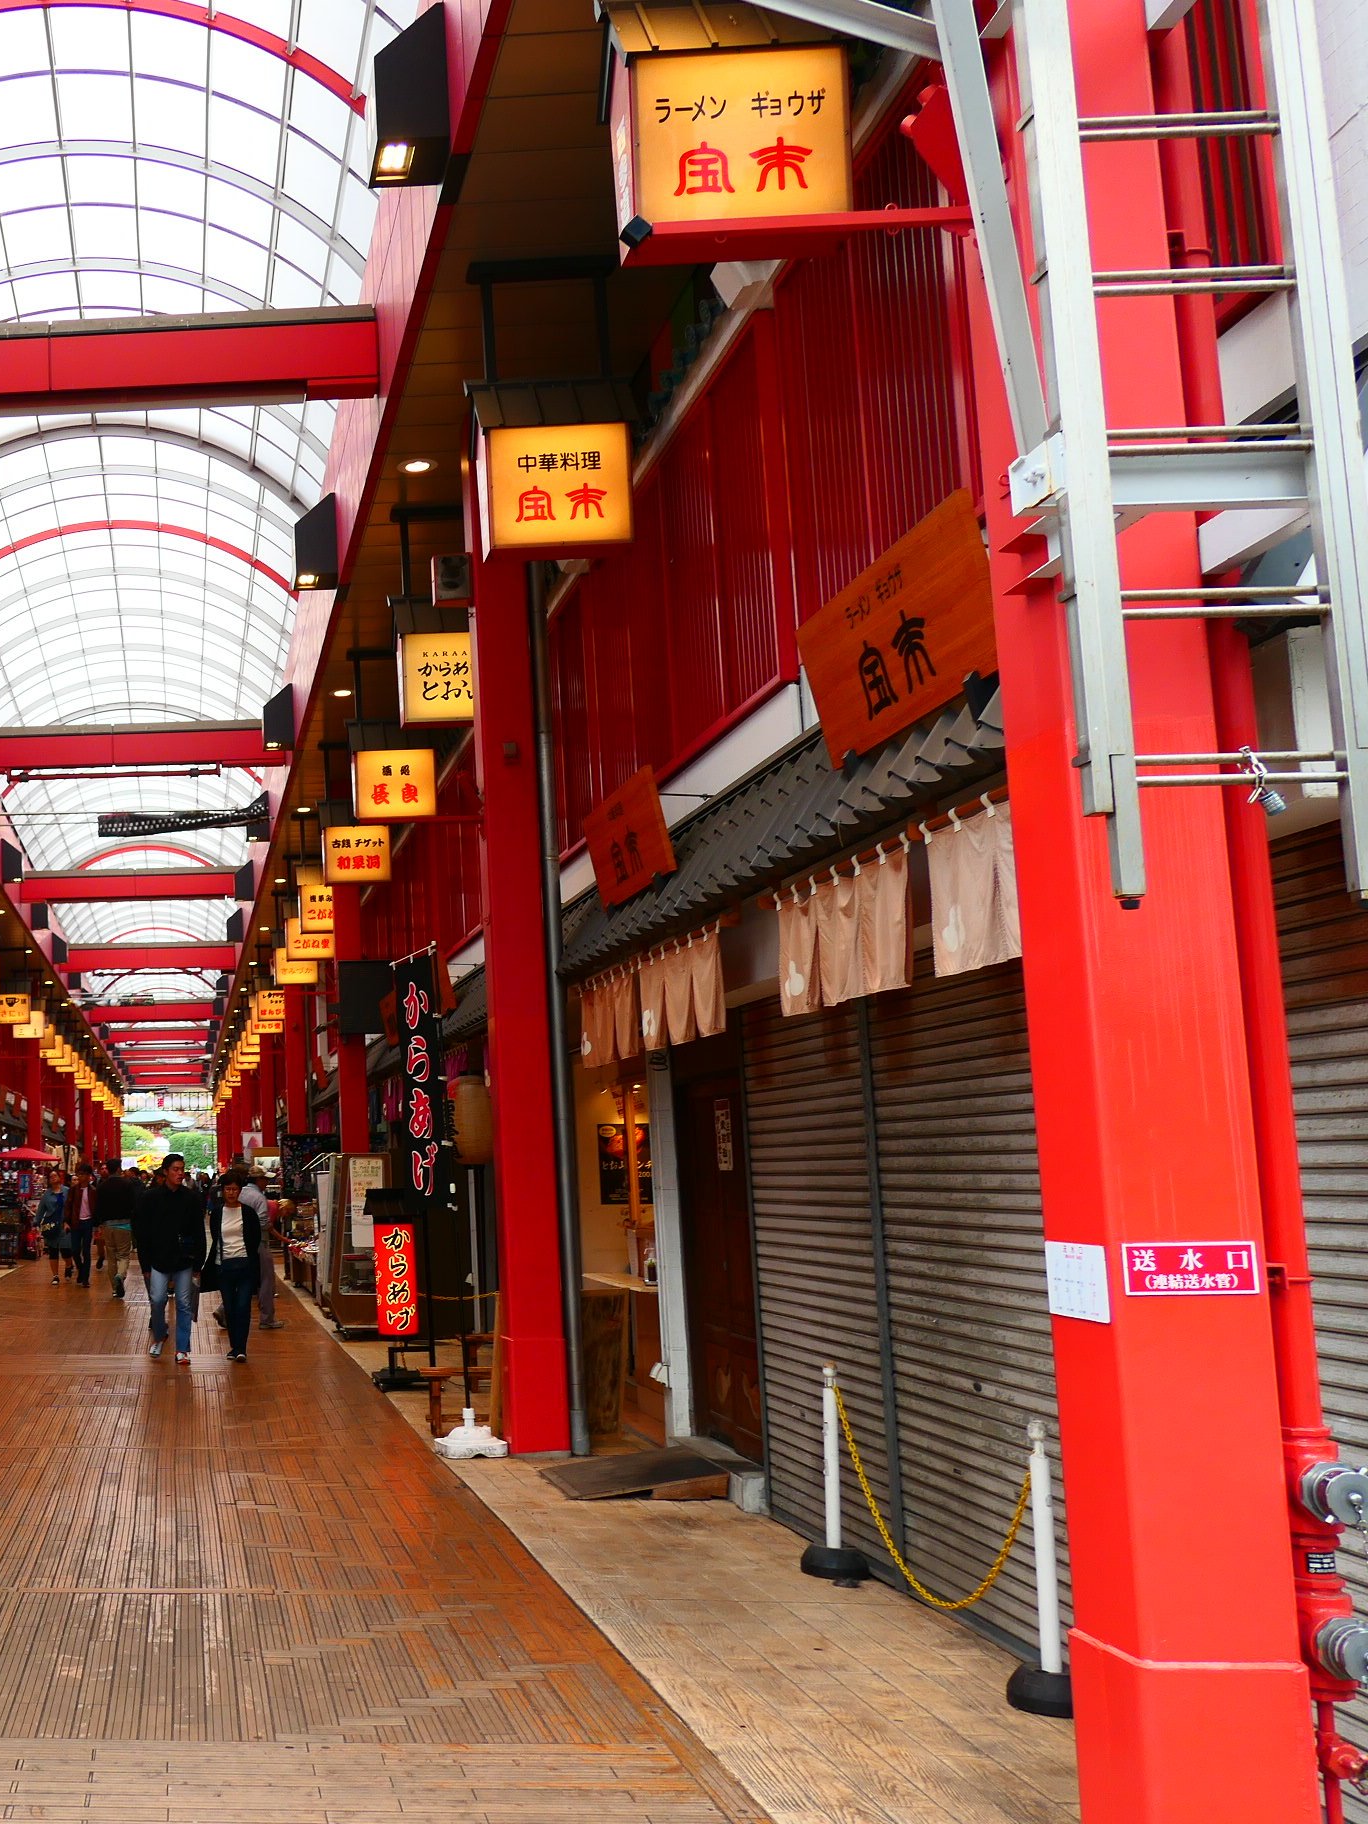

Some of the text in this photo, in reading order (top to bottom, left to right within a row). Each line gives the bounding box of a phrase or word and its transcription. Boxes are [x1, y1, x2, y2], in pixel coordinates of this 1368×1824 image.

[655, 88, 826, 123] ラーメン ギョウザ
[517, 451, 601, 473] 中華料理
[844, 593, 871, 630] ラーメン
[417, 661, 472, 678] からあ
[421, 680, 474, 701] とお
[354, 838, 385, 848] チケット
[403, 981, 438, 1196] からあげ
[1132, 1248, 1249, 1272] 送水口
[382, 1227, 416, 1331] からあげ
[1145, 1272, 1239, 1290] （連結送水管）
